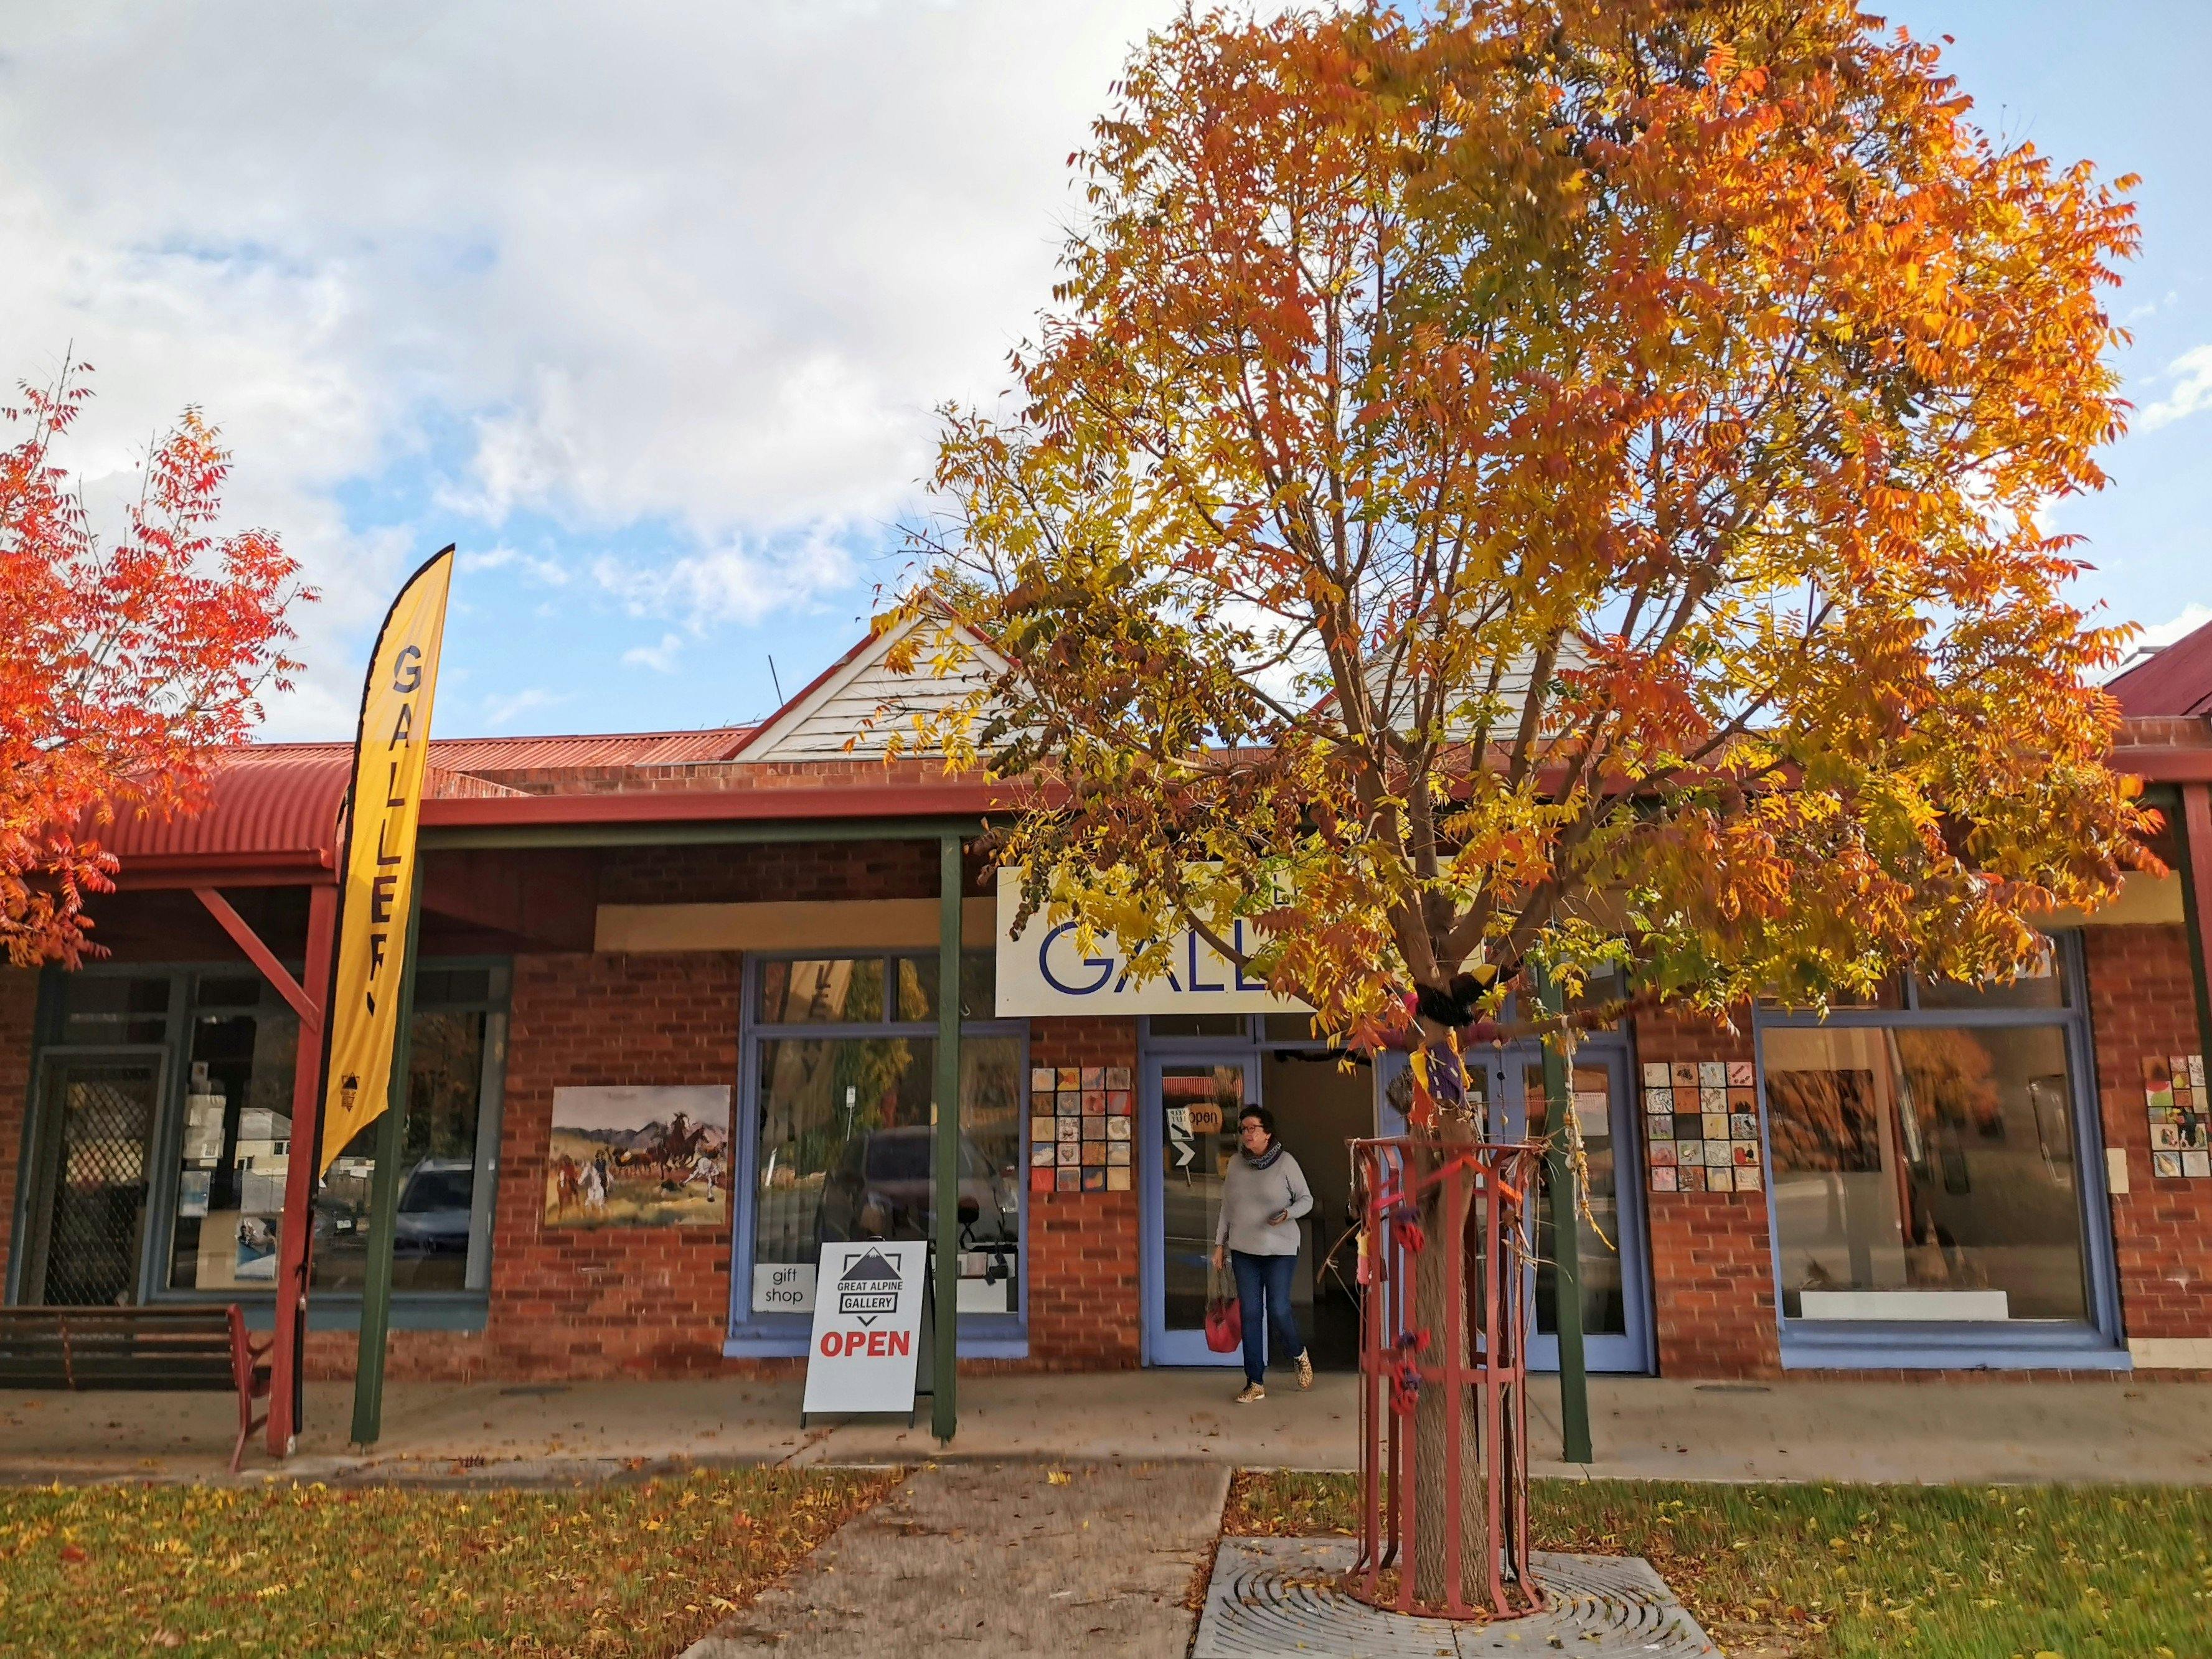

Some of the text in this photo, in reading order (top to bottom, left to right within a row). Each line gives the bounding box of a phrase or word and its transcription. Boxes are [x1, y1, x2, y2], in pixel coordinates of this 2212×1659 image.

[1038, 918, 1268, 995] GALL
[1188, 1111, 1218, 1126] open
[772, 1268, 798, 1285] gift
[837, 1281, 903, 1292] GREAT ALPINE
[765, 1288, 803, 1305] shop
[844, 1297, 893, 1309] GALLERY
[820, 1330, 910, 1357] OPEN
